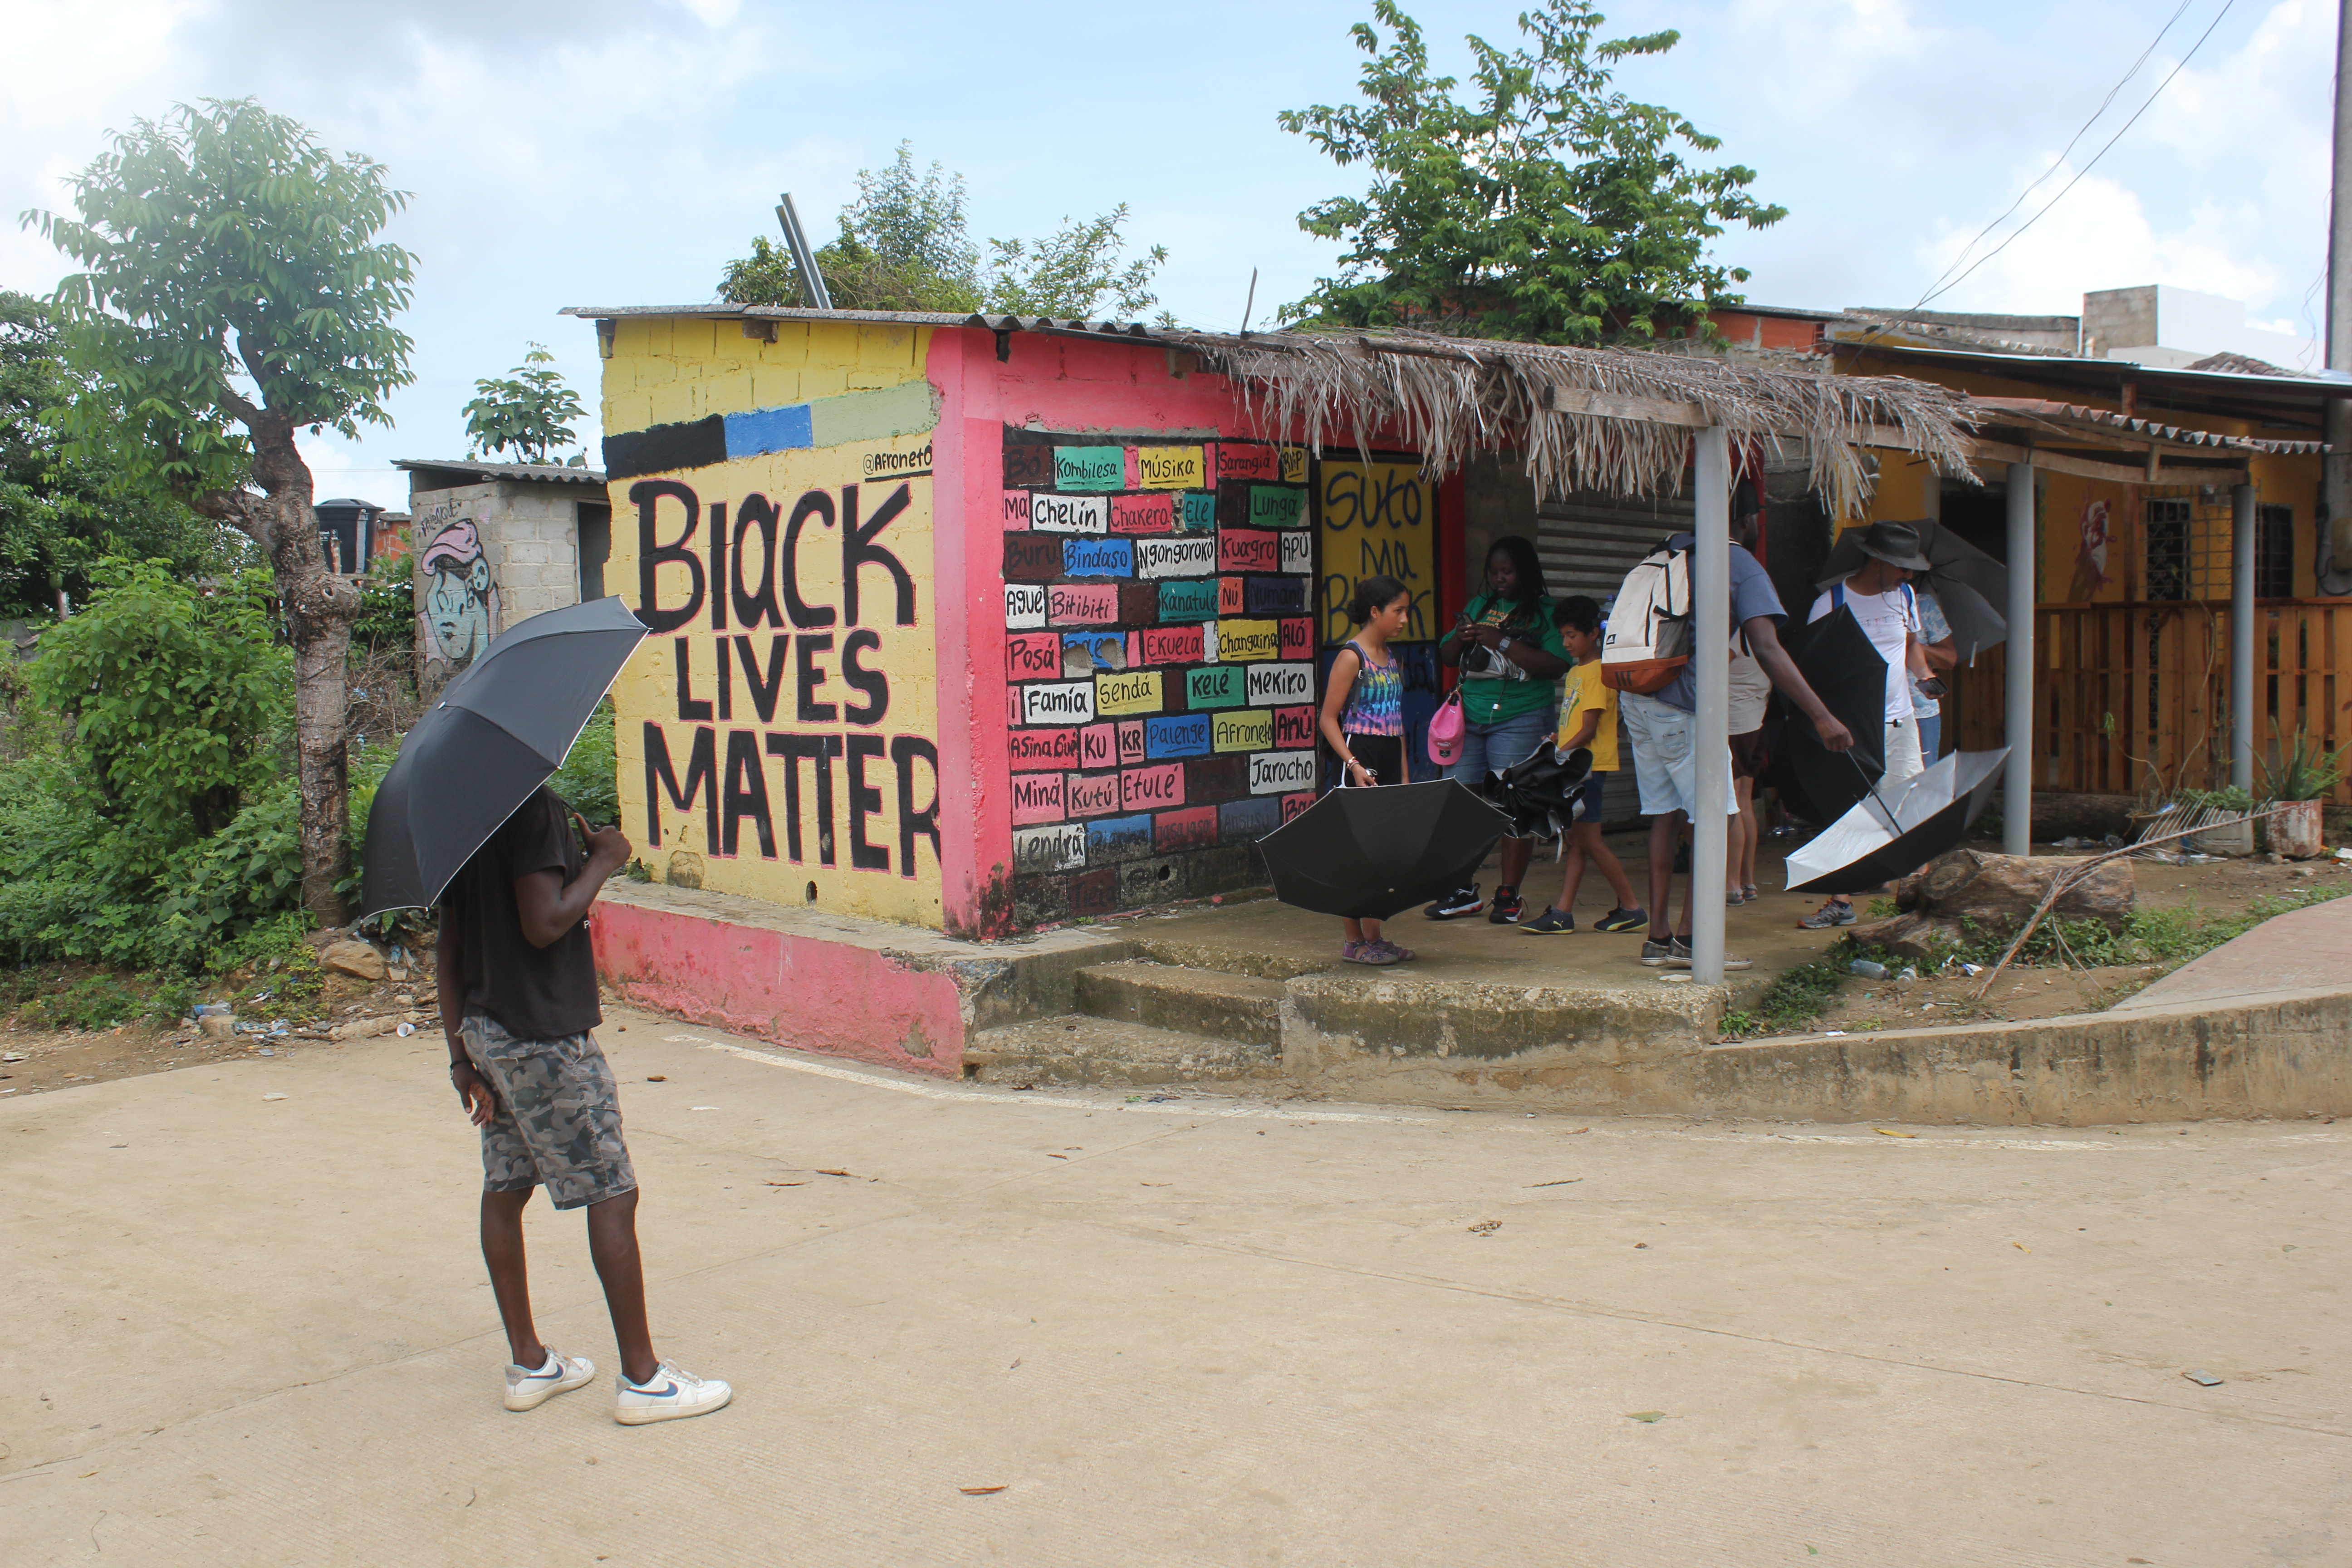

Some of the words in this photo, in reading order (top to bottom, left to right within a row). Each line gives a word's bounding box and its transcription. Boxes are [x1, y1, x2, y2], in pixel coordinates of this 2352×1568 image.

[1064, 544, 1128, 572] Bindaso
[1221, 535, 1275, 563] Kuagro
[1050, 591, 1111, 618] Bitibiti
[674, 628, 891, 726] LIVES
[1084, 733, 1107, 760] KU
[1122, 729, 1142, 751] KR
[1252, 756, 1313, 788] Jarocho
[643, 720, 942, 881] MATTER
